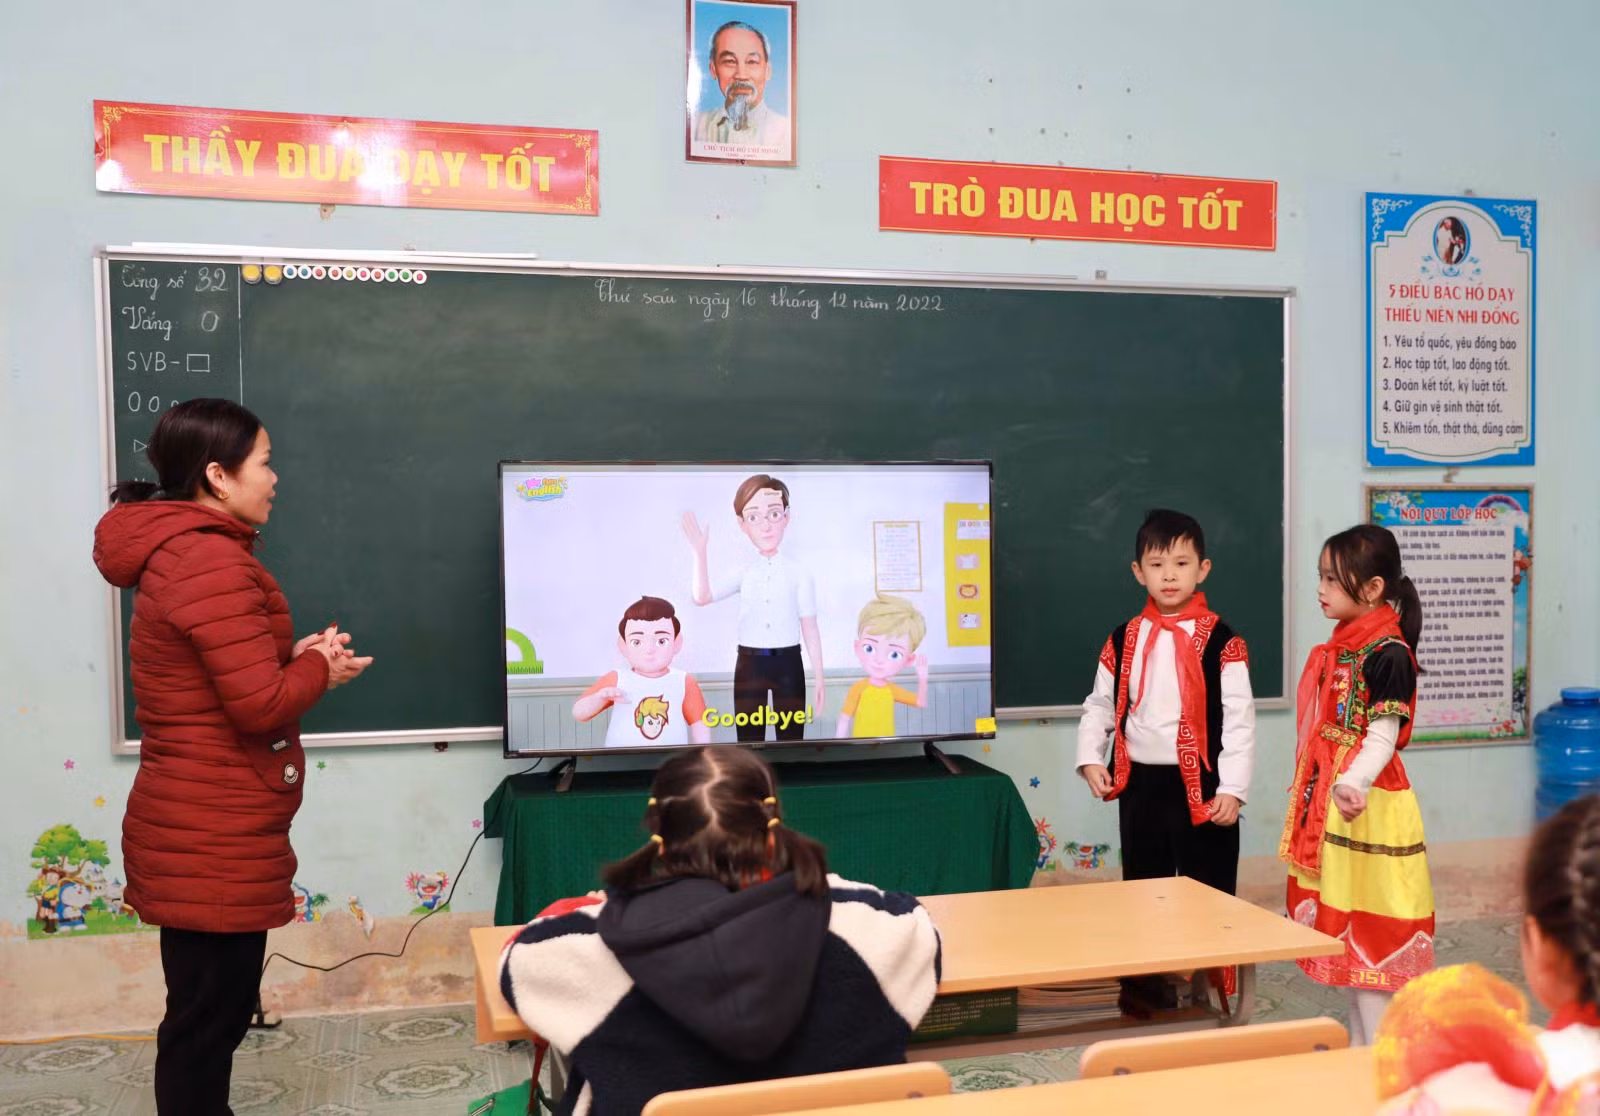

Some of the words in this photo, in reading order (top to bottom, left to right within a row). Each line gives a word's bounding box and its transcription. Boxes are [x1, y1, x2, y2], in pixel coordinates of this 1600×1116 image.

[144, 125, 261, 177] THẦY
[276, 142, 367, 182] ĐUA
[481, 142, 556, 192] TỐT
[909, 177, 985, 217] TRÒ
[998, 186, 1078, 222] ĐUA
[1091, 191, 1166, 232] HỌC
[1178, 188, 1243, 231] TỐT
[195, 267, 228, 291] 32
[595, 278, 631, 303] Thứ
[643, 288, 677, 304] sáu
[689, 292, 730, 318] ngày
[741, 287, 757, 306] 16
[770, 286, 819, 320] tháng
[829, 291, 848, 308] 12
[853, 296, 889, 310] năm
[896, 294, 944, 311] 2022
[1389, 284, 1396, 298] 5
[1400, 279, 1430, 299] ĐIỀU
[1434, 282, 1461, 300] BÁC
[1465, 281, 1485, 300] HỒ
[1488, 287, 1515, 305] DẠY
[1385, 302, 1421, 322] THIẾU
[1426, 305, 1454, 323] NIÊN
[1458, 309, 1478, 324] NHI
[1482, 305, 1520, 325] ĐỒNG
[1383, 335, 1392, 348] 1.
[1395, 335, 1412, 348] Yêu
[1456, 337, 1472, 351] yêu
[1383, 357, 1391, 369] 2.
[1394, 357, 1412, 373] Học
[1415, 358, 1430, 373] tập
[1452, 358, 1466, 370] lao
[1469, 358, 1492, 374] động
[1383, 378, 1391, 391] 3.
[1383, 400, 1391, 412] 4.
[1444, 401, 1463, 413] sinh
[1383, 422, 1391, 434] 5.
[1475, 508, 1497, 522] HỌC
[702, 704, 814, 730] Goodbye!
